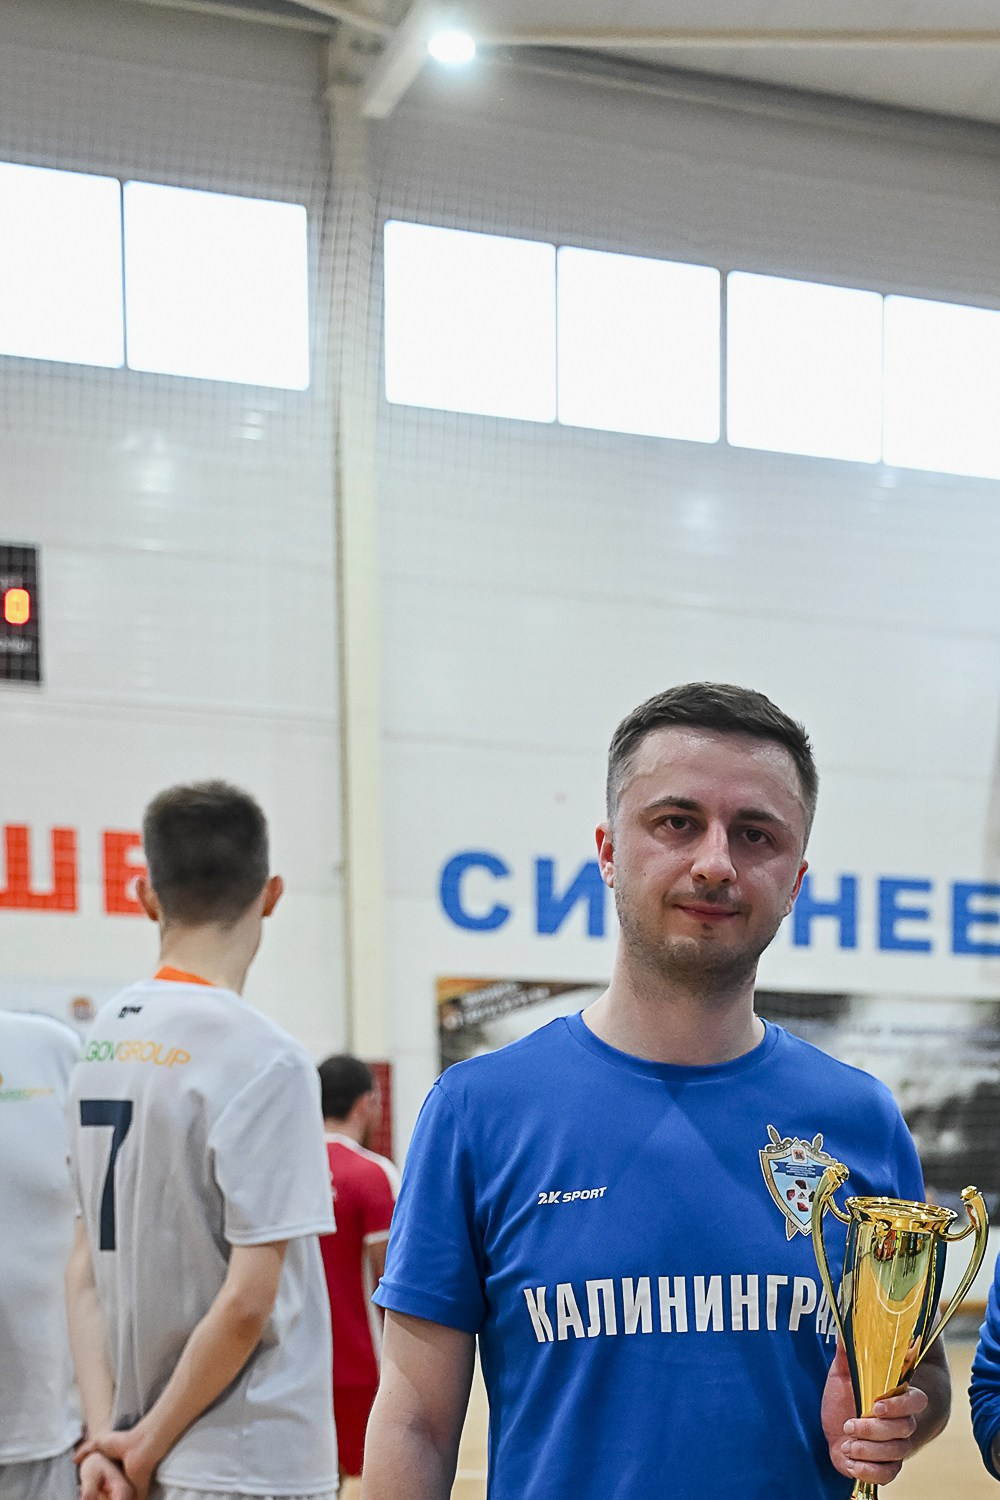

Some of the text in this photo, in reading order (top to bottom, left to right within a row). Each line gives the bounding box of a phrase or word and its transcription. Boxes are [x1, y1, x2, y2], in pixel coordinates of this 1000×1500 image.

[80, 1099, 133, 1251] 7
[537, 1186, 607, 1205] 2K SPORT
